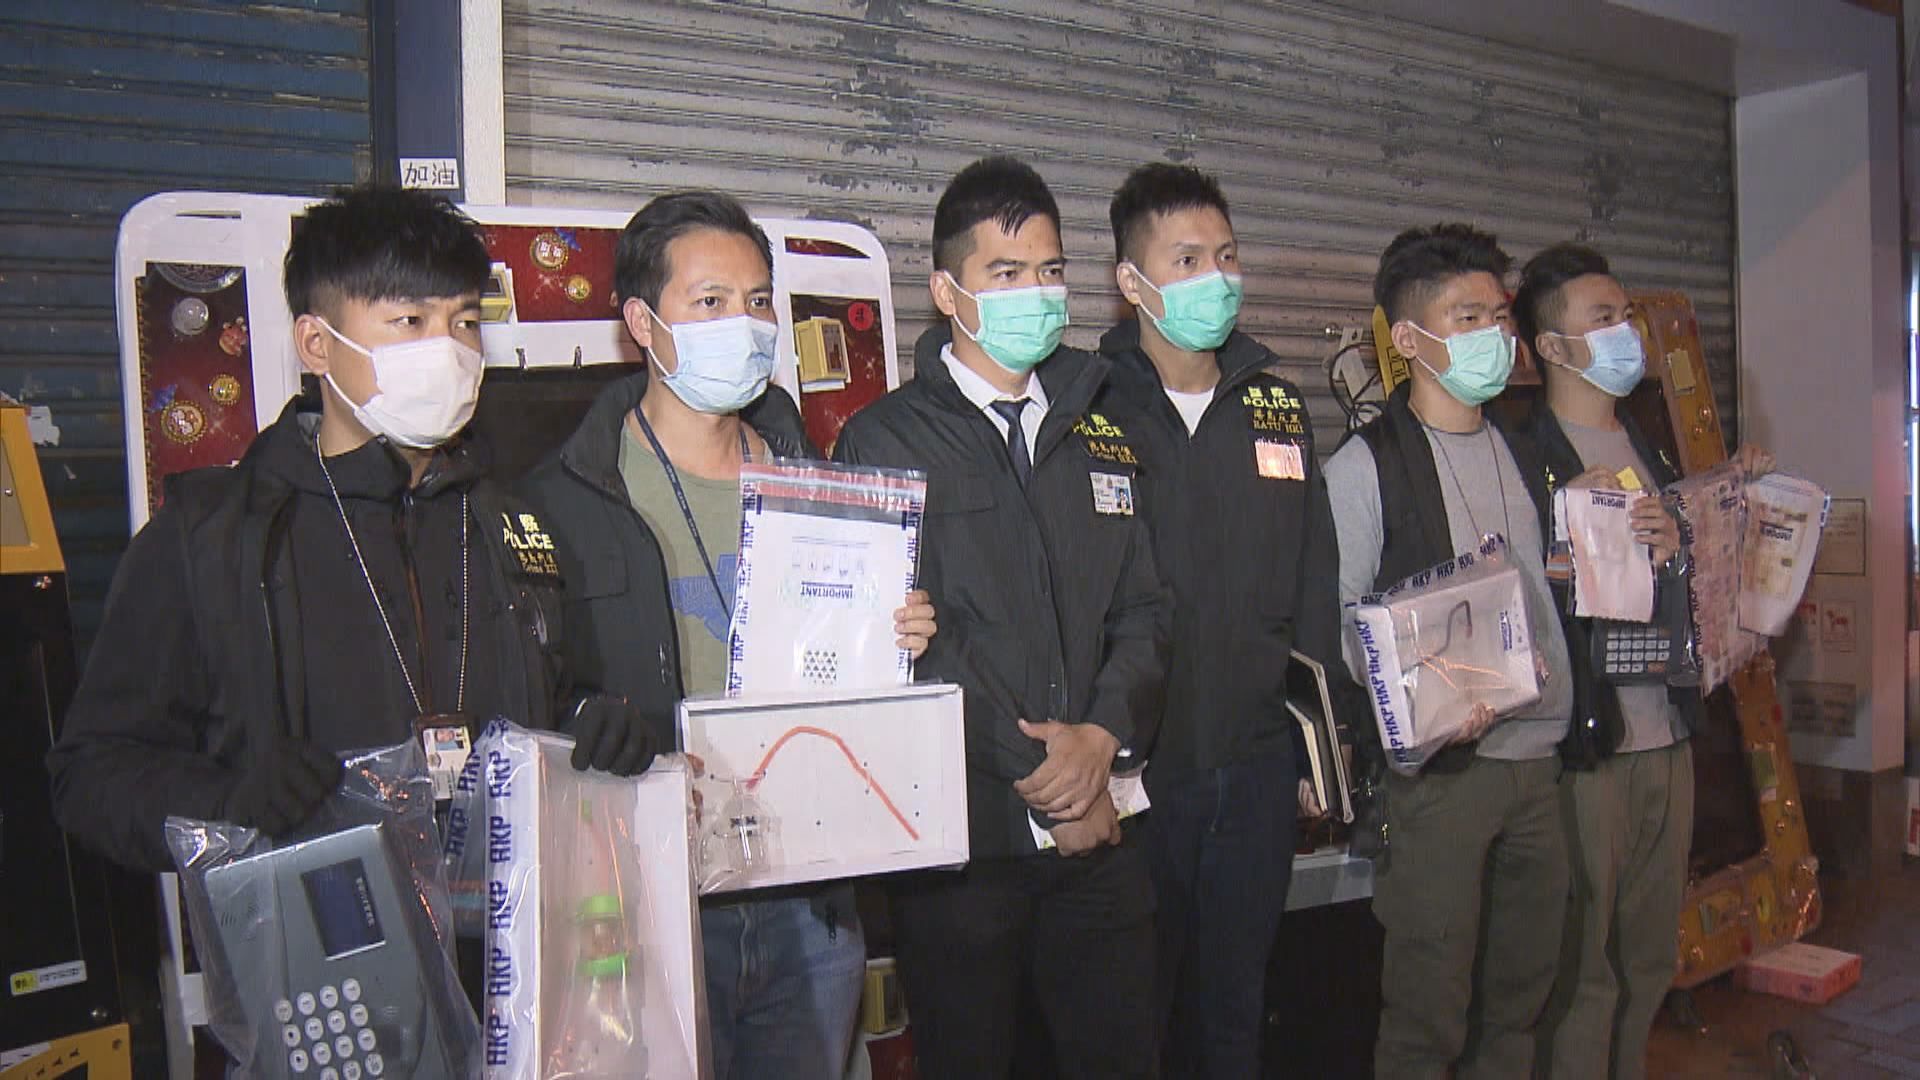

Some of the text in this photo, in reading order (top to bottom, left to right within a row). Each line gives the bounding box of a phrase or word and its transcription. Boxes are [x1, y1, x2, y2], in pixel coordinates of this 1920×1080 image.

[404, 161, 455, 185] 加油
[1242, 396, 1301, 409] POLICE
[800, 584, 853, 599] IMPORTANT
[1366, 645, 1381, 675] HKP
[1371, 676, 1390, 706] HKP
[1381, 707, 1401, 737] HKP
[489, 750, 511, 798] HKP
[489, 815, 512, 864] HKP
[488, 947, 511, 996] HKP
[487, 1015, 509, 1066] HKP
